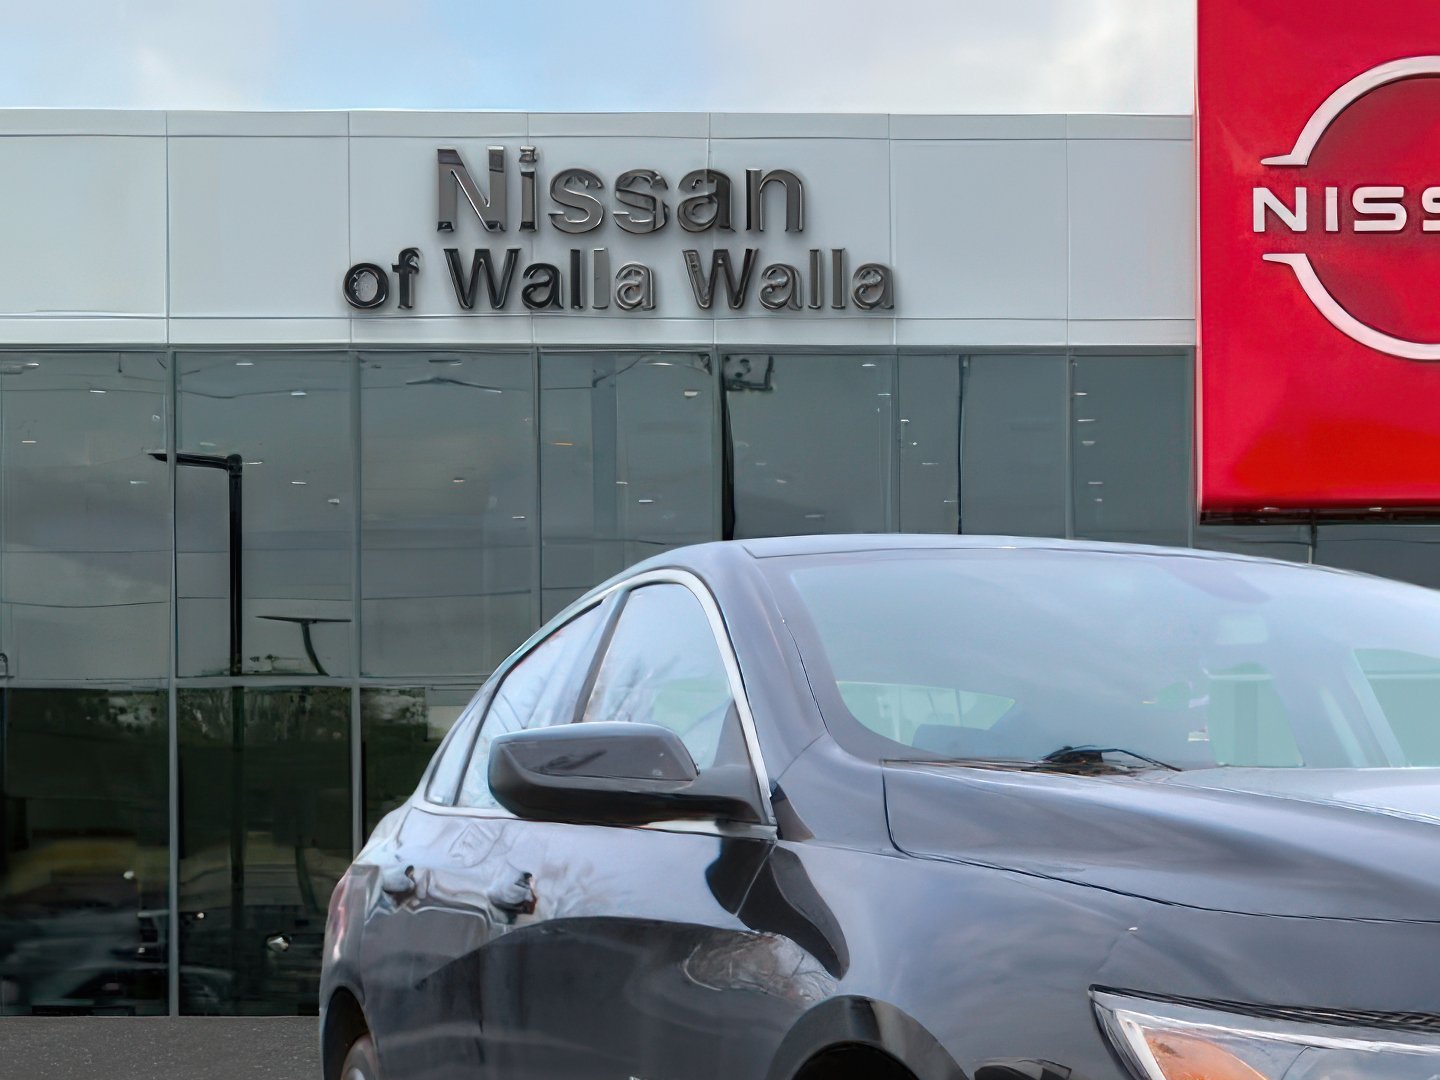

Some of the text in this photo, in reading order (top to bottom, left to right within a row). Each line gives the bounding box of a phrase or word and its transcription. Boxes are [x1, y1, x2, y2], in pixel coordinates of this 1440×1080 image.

[436, 144, 806, 234] Nissan
[342, 246, 895, 311] of Walla Walla
